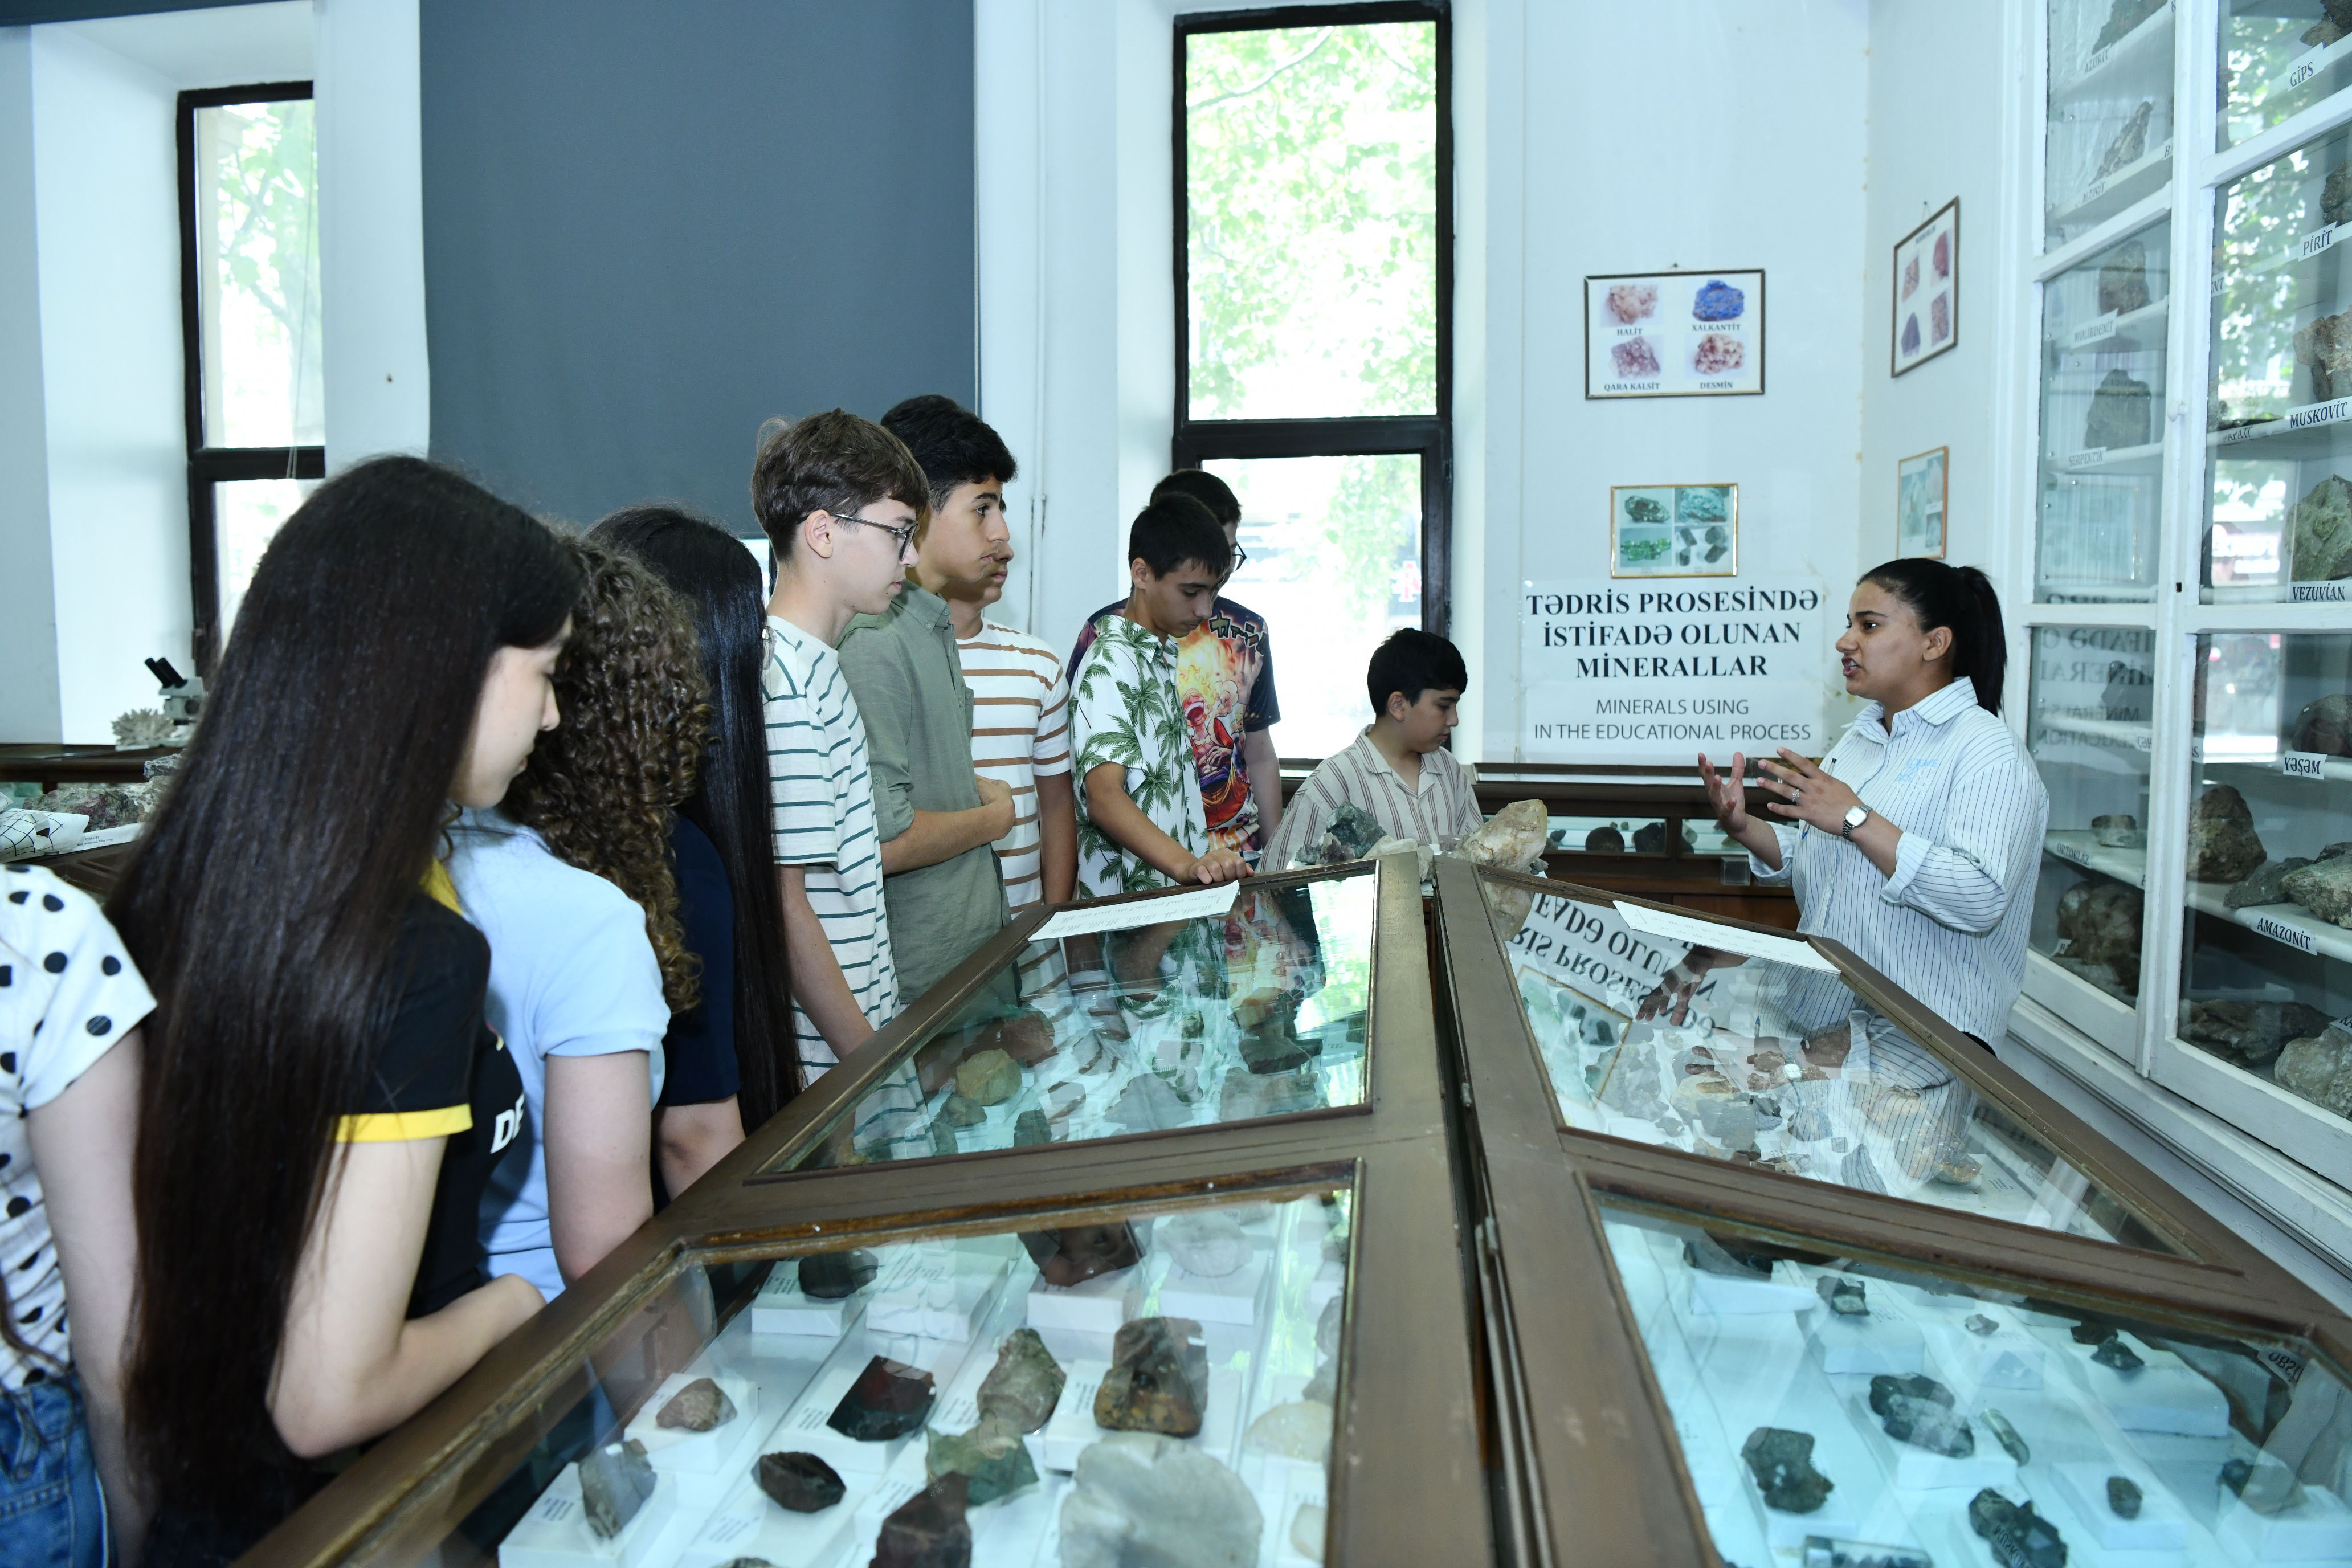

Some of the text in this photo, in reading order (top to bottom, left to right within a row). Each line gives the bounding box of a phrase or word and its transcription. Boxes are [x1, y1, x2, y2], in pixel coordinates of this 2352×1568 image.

[2290, 61, 2314, 87] GİPS
[2302, 229, 2333, 256] PİRİT
[1616, 326, 1643, 336] HALİT
[1692, 322, 1742, 332] XALKANTİT
[1604, 382, 1661, 392] QARA KALSİT
[1700, 380, 1734, 389] DESMİN
[2290, 400, 2349, 428] MUSKOVİT
[1526, 586, 1819, 615] TƏDRİS PROSESİNDƏ
[2293, 583, 2345, 601] VEZUVİAN
[1544, 620, 1802, 647] İSTİFADƏ OLUNAN
[1575, 652, 1768, 679] MİNERALLAR
[1596, 699, 1750, 714] MINERALS USING
[1535, 724, 1811, 740] IN THE EDUCATIONAL PROCESS
[2284, 757, 2321, 776] YƏŞƏM
[2257, 917, 2311, 950] AMAZONİT
